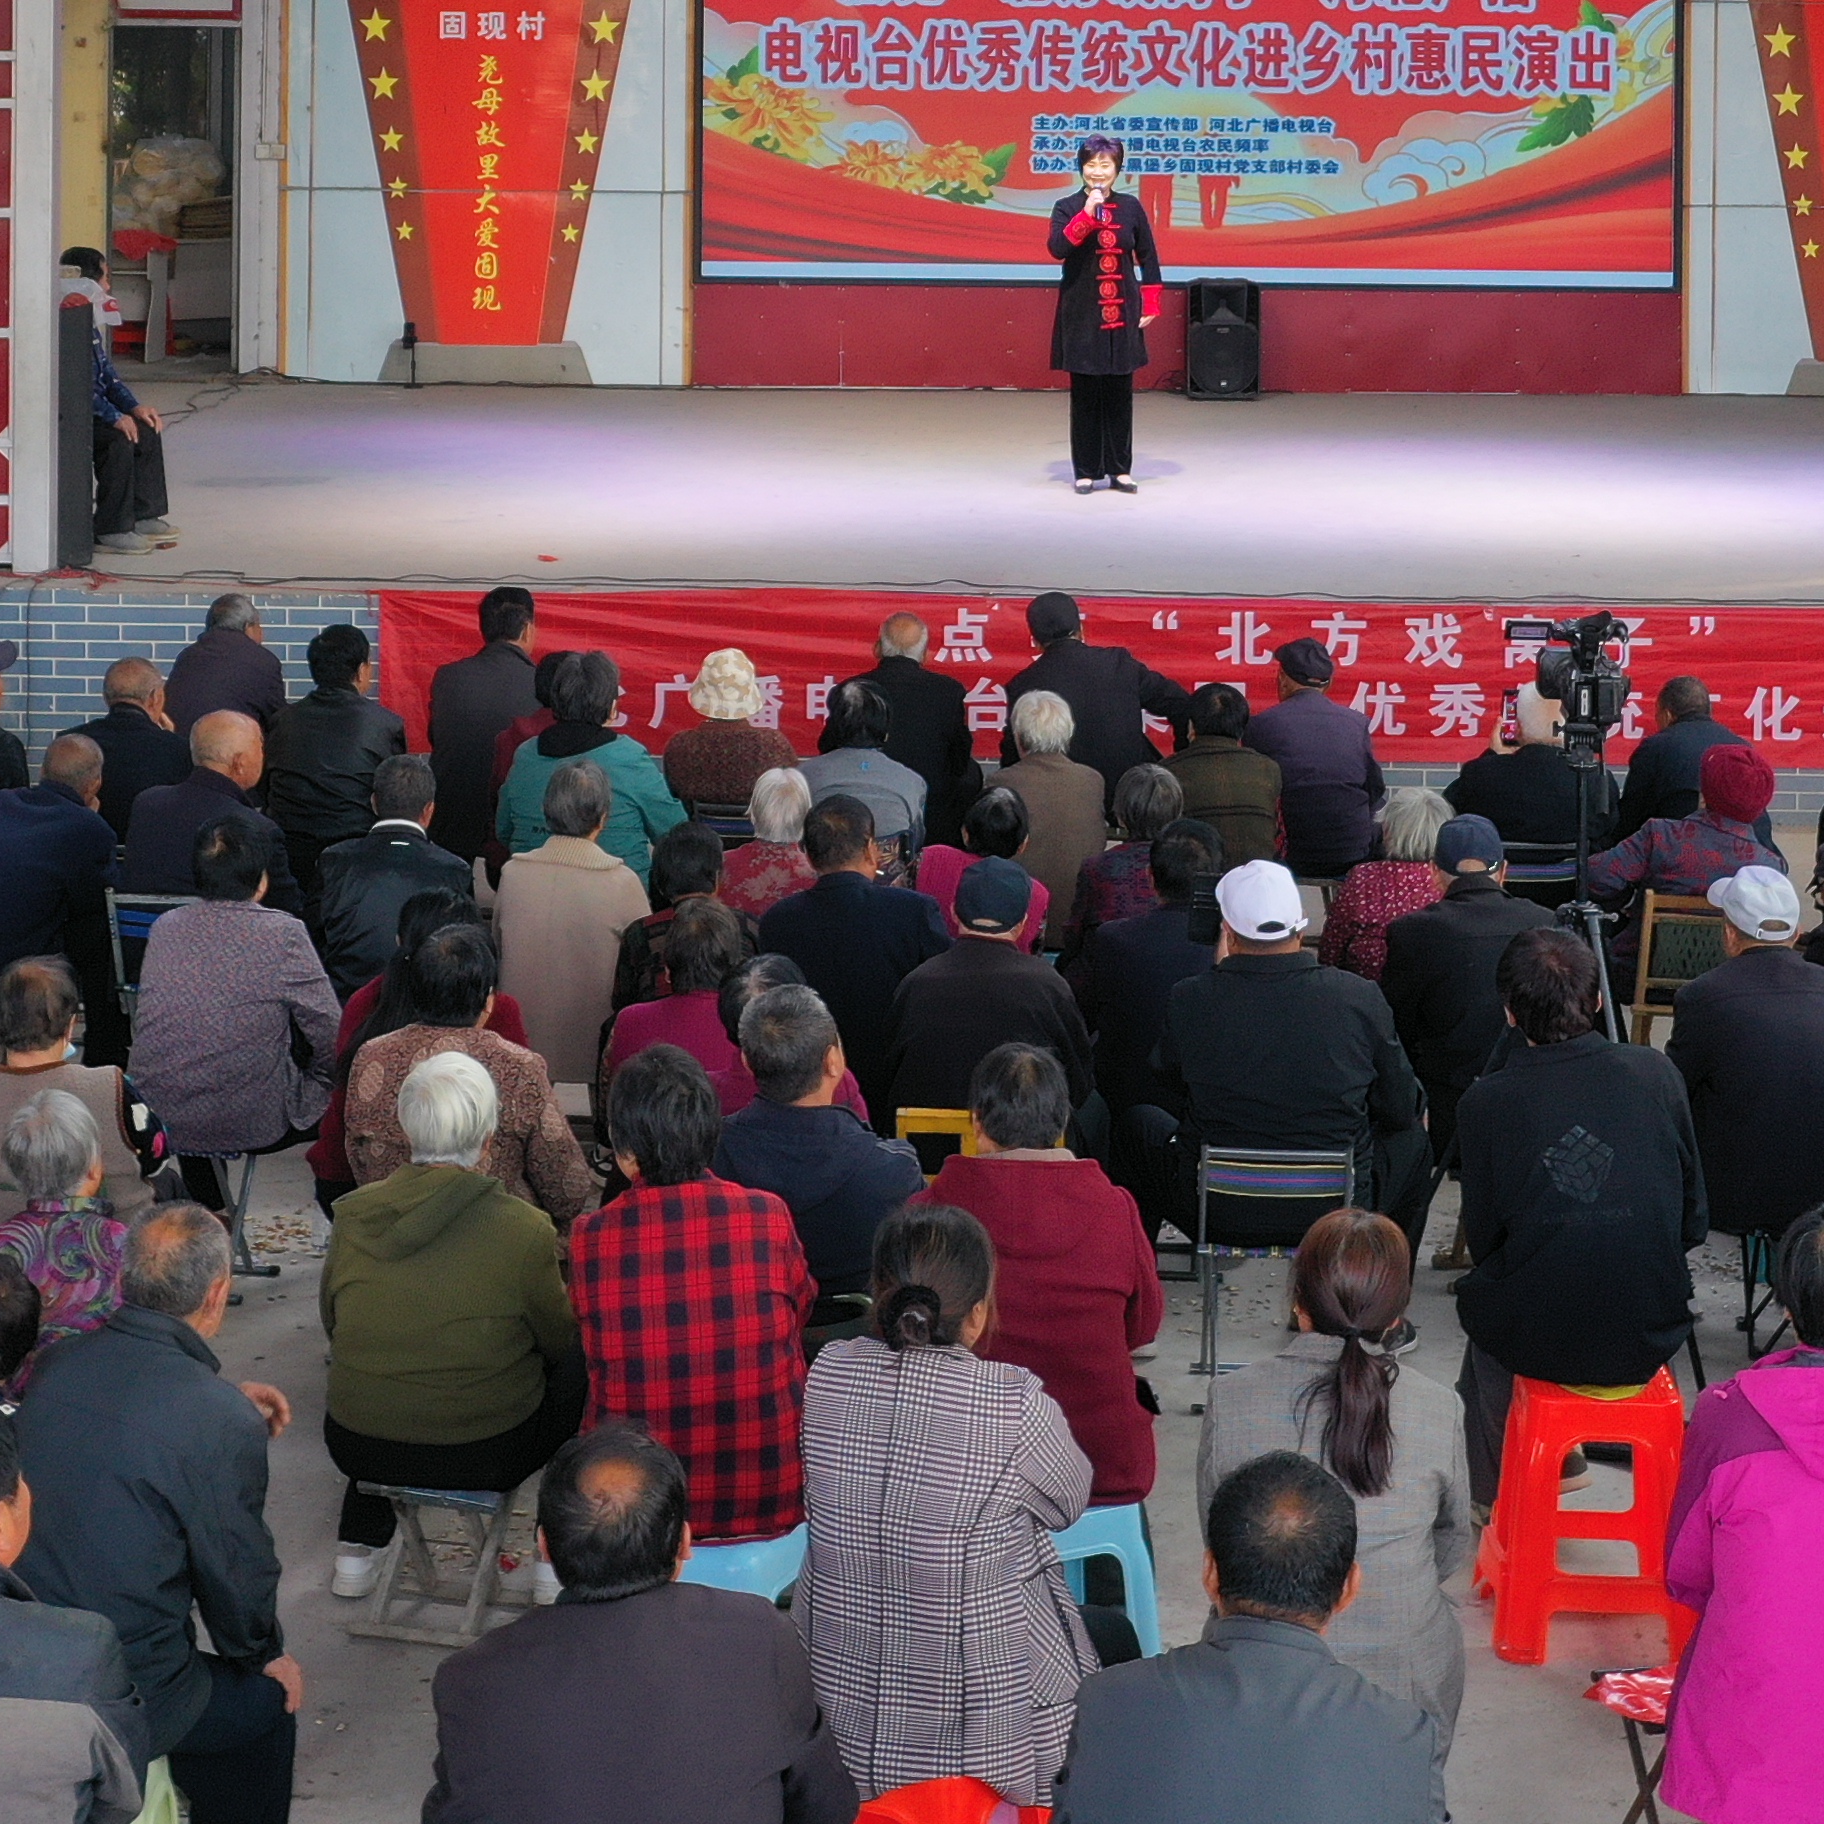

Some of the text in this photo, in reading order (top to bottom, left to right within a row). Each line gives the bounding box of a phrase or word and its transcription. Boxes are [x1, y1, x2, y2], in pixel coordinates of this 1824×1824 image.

[439, 10, 546, 40] 固现村
[760, 18, 1617, 94] 电视台优秀传统文化进乡村惠民演出
[1208, 117, 1333, 135] 河北广播电视台
[471, 54, 506, 311] 尧母故里大爱固现
